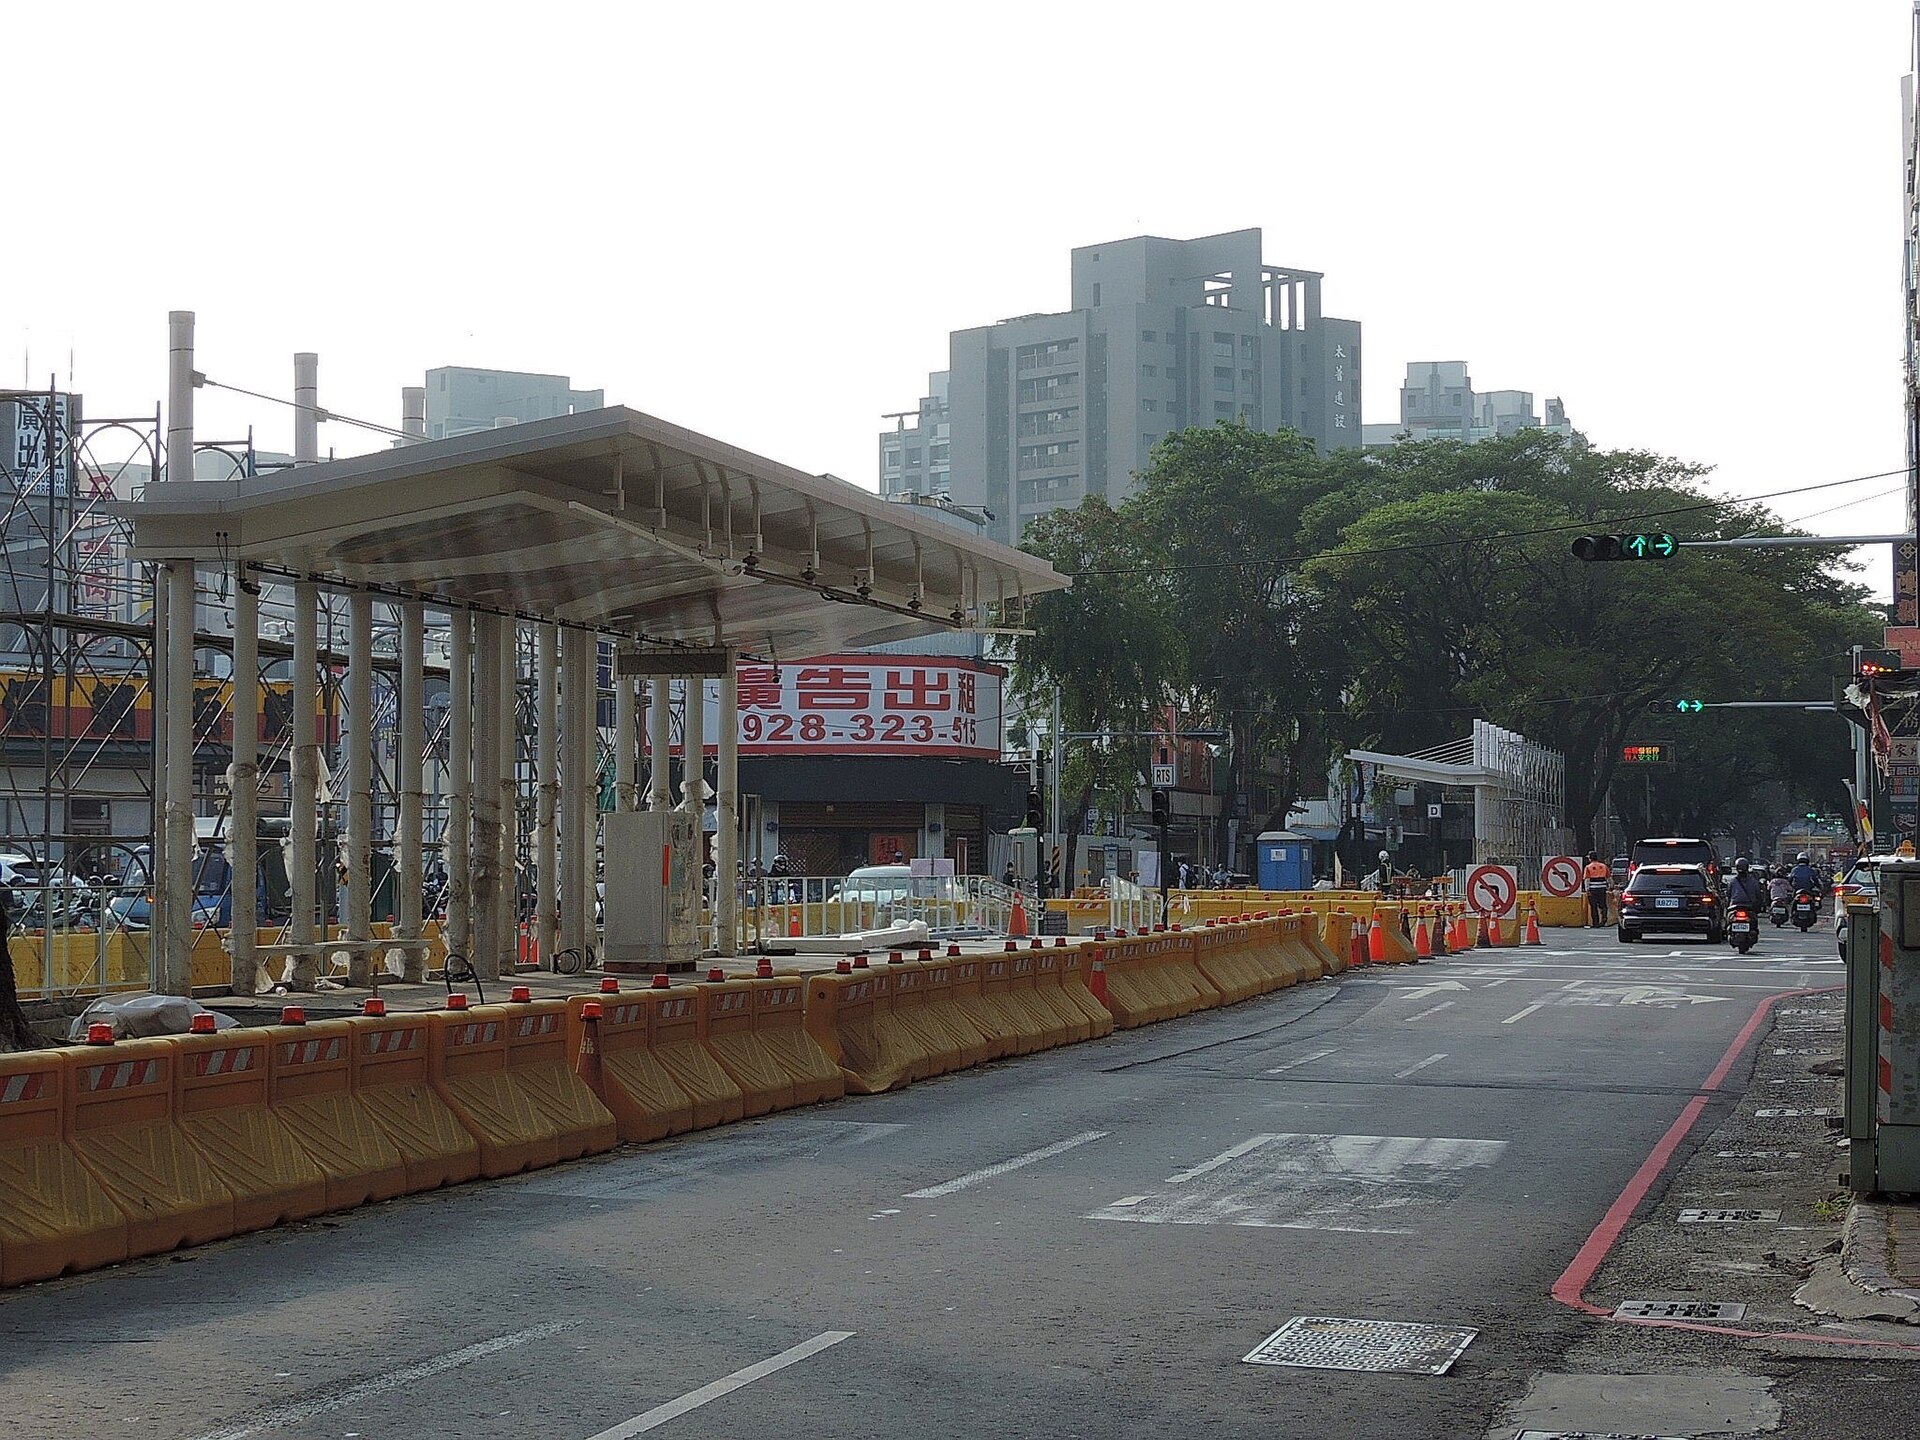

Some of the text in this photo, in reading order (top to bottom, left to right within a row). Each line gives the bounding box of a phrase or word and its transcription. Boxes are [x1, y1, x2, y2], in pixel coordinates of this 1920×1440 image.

[737, 668, 976, 714] 廣告出租
[737, 714, 976, 745] 928-323-515
[1156, 769, 1171, 783] RTS
